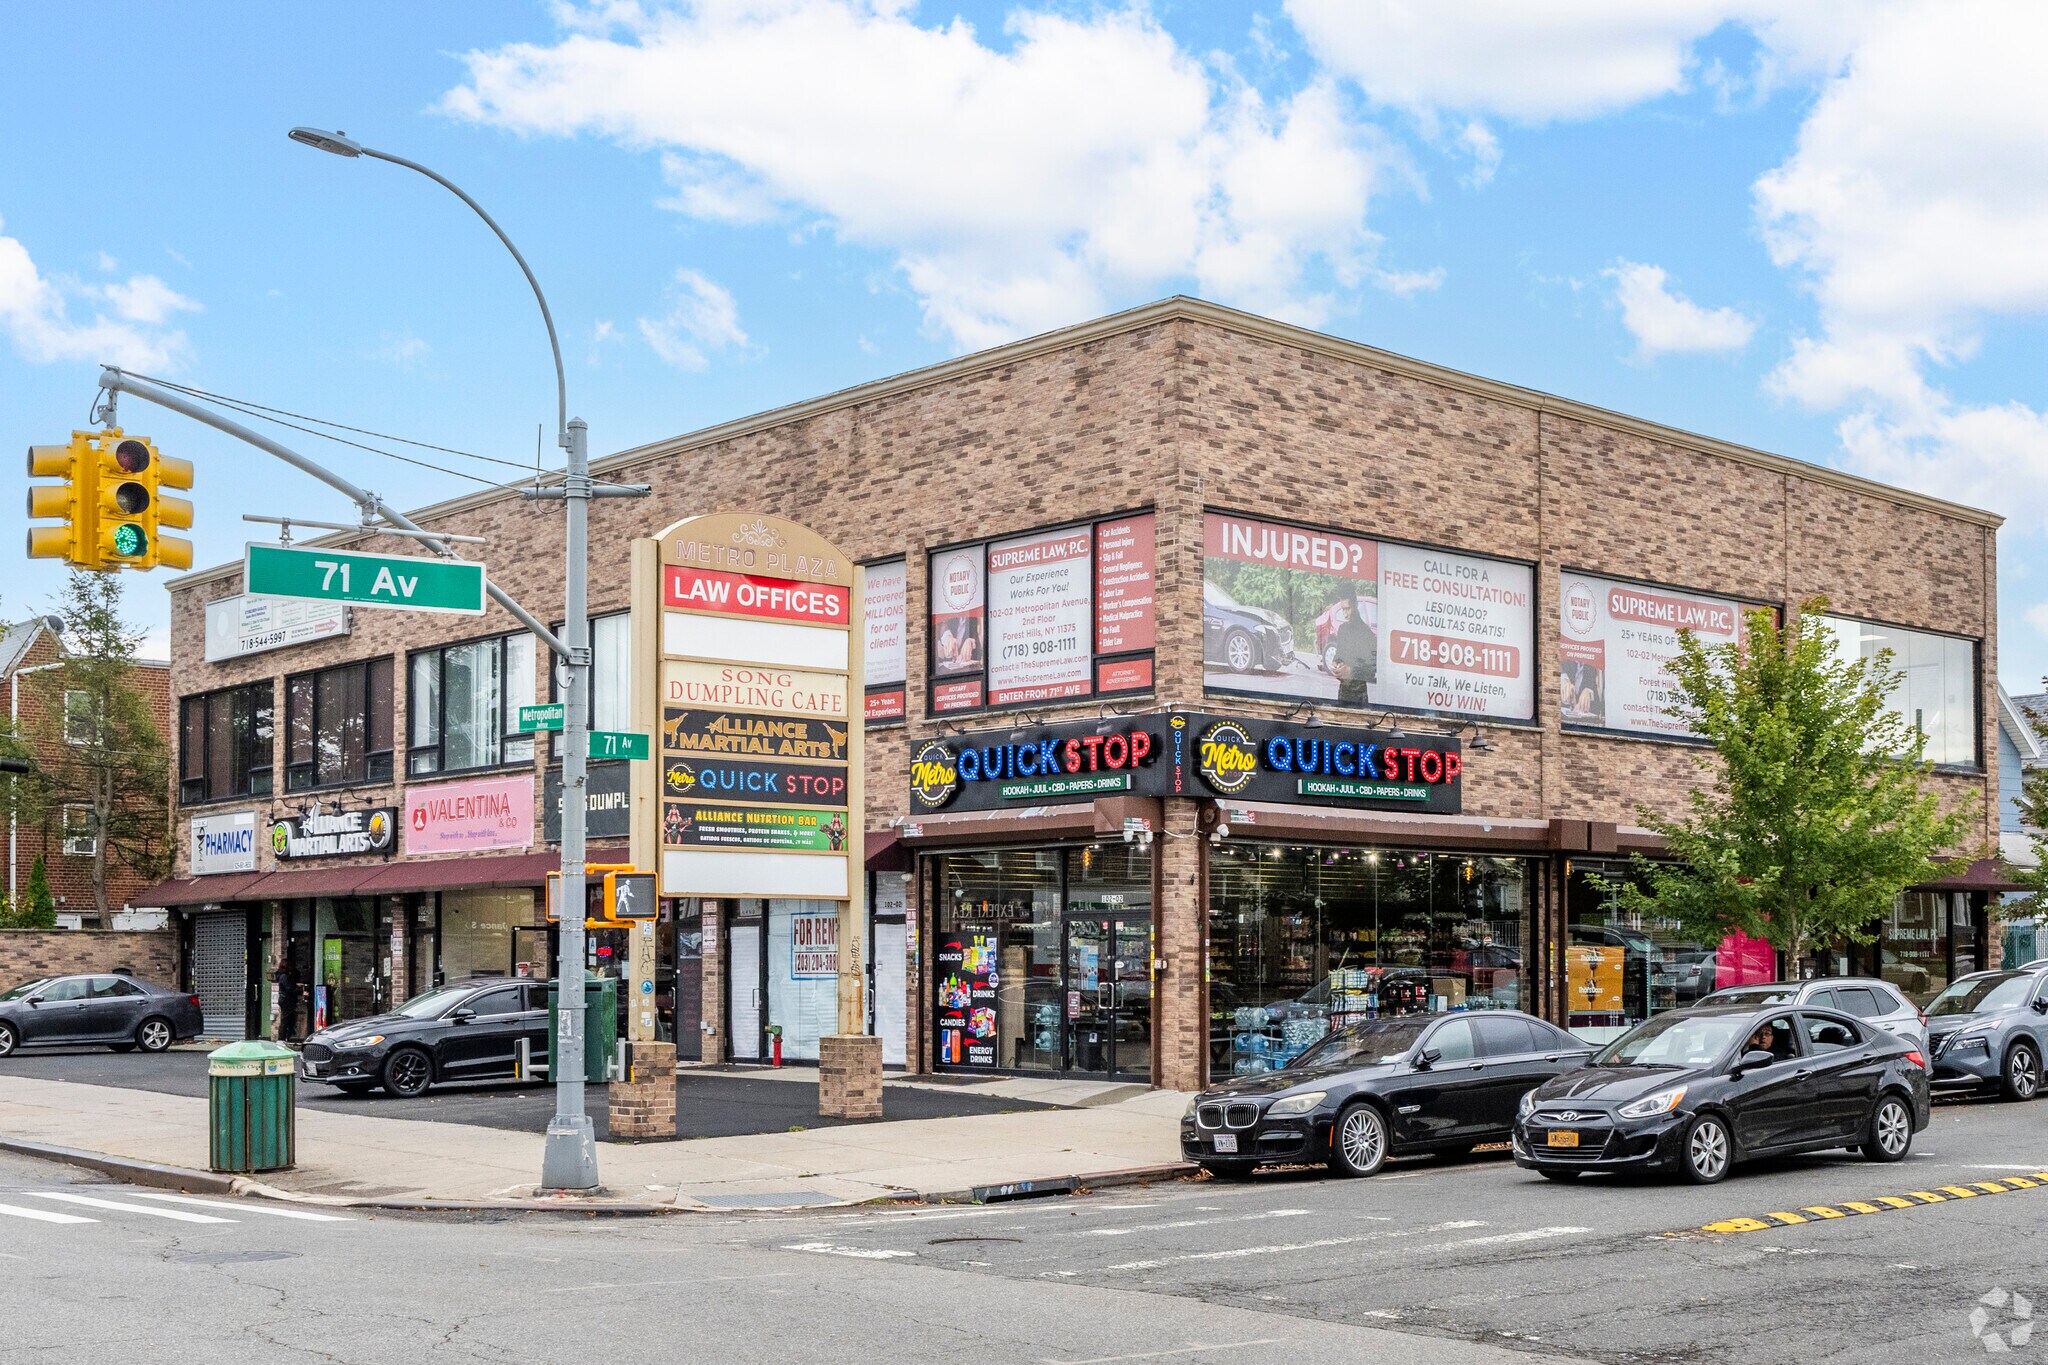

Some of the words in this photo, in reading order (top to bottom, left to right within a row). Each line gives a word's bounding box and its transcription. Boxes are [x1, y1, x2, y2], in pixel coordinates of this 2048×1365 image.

[991, 547, 1040, 568] SUPREME
[1042, 542, 1067, 559] LAW,
[1069, 539, 1088, 555] P.C.
[1222, 522, 1363, 573] INJURED?
[676, 539, 757, 568] METRO
[767, 553, 838, 578] PLAZA
[314, 560, 350, 593] 71
[370, 566, 419, 598] Av
[949, 570, 970, 583] NOTARY
[1009, 576, 1024, 584] Our
[1025, 568, 1069, 583] Experience
[1423, 560, 1452, 576] CALL
[1455, 565, 1478, 580] FOR
[1481, 570, 1490, 582] A
[867, 578, 880, 590] We
[882, 575, 902, 587] have
[950, 584, 969, 596] PUBLIC
[1010, 588, 1034, 599] Works
[1036, 586, 1050, 595] For
[1052, 582, 1070, 593] You!
[1384, 570, 1418, 590] FREE
[1423, 578, 1526, 607] CONSULTATION!
[674, 576, 731, 604] LAW
[736, 584, 840, 616] OFFICES
[864, 589, 905, 605] recovered
[1570, 597, 1590, 608] NOTARY
[864, 604, 904, 620] MILLIONS
[989, 608, 1013, 618] 102-02
[1014, 601, 1060, 615] Metropolitan
[1061, 597, 1090, 608] Avenue,
[1425, 600, 1488, 620] LESIONADO?
[1571, 609, 1590, 620] PUBLIC
[1611, 594, 1675, 622] SUPREME
[1677, 605, 1708, 629] LAW,
[1710, 610, 1732, 630] P.C.
[870, 623, 882, 635] for
[884, 622, 898, 632] our
[1022, 617, 1035, 626] 2nd
[1037, 615, 1056, 624] Floor
[1406, 613, 1465, 632] CONSULTAS
[1468, 623, 1506, 638] GRATIS!
[241, 631, 286, 650] 718-544-5997
[1002, 632, 1024, 641] Forest
[1044, 626, 1055, 635] NY
[1057, 623, 1076, 633] 11375
[1621, 629, 1635, 639] 25+
[1637, 631, 1663, 644] YEARS
[1665, 635, 1676, 645] OF
[869, 636, 899, 650] clients!
[1002, 643, 1029, 660] (718)
[1032, 637, 1076, 654] 908-1111
[1399, 636, 1511, 673] 718-908-1111
[1626, 648, 1650, 660] 102-02
[990, 655, 1089, 674] contact@TheSupremeLaw.com
[721, 668, 793, 687] SONG
[997, 669, 1082, 685] www.TheSupremeLaw.com
[1404, 672, 1424, 686] You
[1428, 675, 1451, 690] Talk,
[1454, 678, 1471, 691] We
[1474, 681, 1507, 698] Listen,
[1639, 676, 1660, 687] Forest
[670, 680, 783, 708] DUMPLING
[792, 691, 842, 712] CAFE
[998, 690, 1023, 702] ENTER
[1025, 688, 1047, 700] FROM
[1064, 684, 1081, 695] AVE
[1427, 691, 1453, 707] YOU
[1457, 695, 1488, 712] WIN!
[1646, 690, 1667, 703] (718)
[869, 699, 880, 707] 25+
[880, 698, 895, 706] Years
[872, 707, 901, 716] Experience
[522, 706, 563, 722] Metropolitan
[705, 714, 808, 739] ALLIANCE
[603, 735, 617, 755] 71
[621, 736, 633, 749] Av
[679, 732, 775, 754] MARTIAL
[778, 739, 831, 758] ARTS
[1174, 730, 1182, 765] QUICK
[1216, 735, 1241, 743] QUICK
[958, 738, 1061, 781] QUICK
[1065, 731, 1151, 774] STOP
[1201, 742, 1256, 776] Metro
[1267, 735, 1379, 778] QUICK
[1383, 746, 1463, 785] STOP
[666, 770, 696, 786] Metro
[699, 768, 780, 793] QUICK
[786, 774, 845, 796] STOP
[911, 761, 956, 792] Metro
[1174, 765, 1182, 793] STOP
[1003, 785, 1029, 796] HOOKAH
[1032, 784, 1048, 794] JUUL
[1052, 782, 1065, 792] CBD
[1069, 780, 1094, 791] PAPERS
[1097, 778, 1121, 788] DRINKS
[1307, 782, 1336, 793] HOOKAH
[1339, 784, 1356, 794] JUUL
[1359, 786, 1373, 795] CBD
[1376, 787, 1400, 797] PAPERS
[1403, 788, 1426, 798] DRINKS
[428, 793, 511, 822] VALENTINA
[299, 802, 363, 836] ALLIANCE
[499, 818, 504, 828] &
[505, 816, 518, 828] CO
[695, 810, 743, 823] ALLIANCE
[798, 815, 818, 827] BAR
[205, 829, 253, 855] PHARMACY
[290, 835, 340, 857] MARTIAL
[340, 832, 371, 853] ARTS
[1102, 895, 1123, 903] 102-02
[793, 918, 813, 945] FOR
[815, 917, 839, 945] REN
[1888, 928, 1916, 940] SUPREME
[794, 954, 811, 972] (203)
[938, 953, 963, 961] SNACKS
[972, 990, 996, 998] DRINKS
[940, 1018, 966, 1027] CANDIES
[969, 1046, 994, 1055] ENERGY
[970, 1055, 993, 1063] DRINKS
